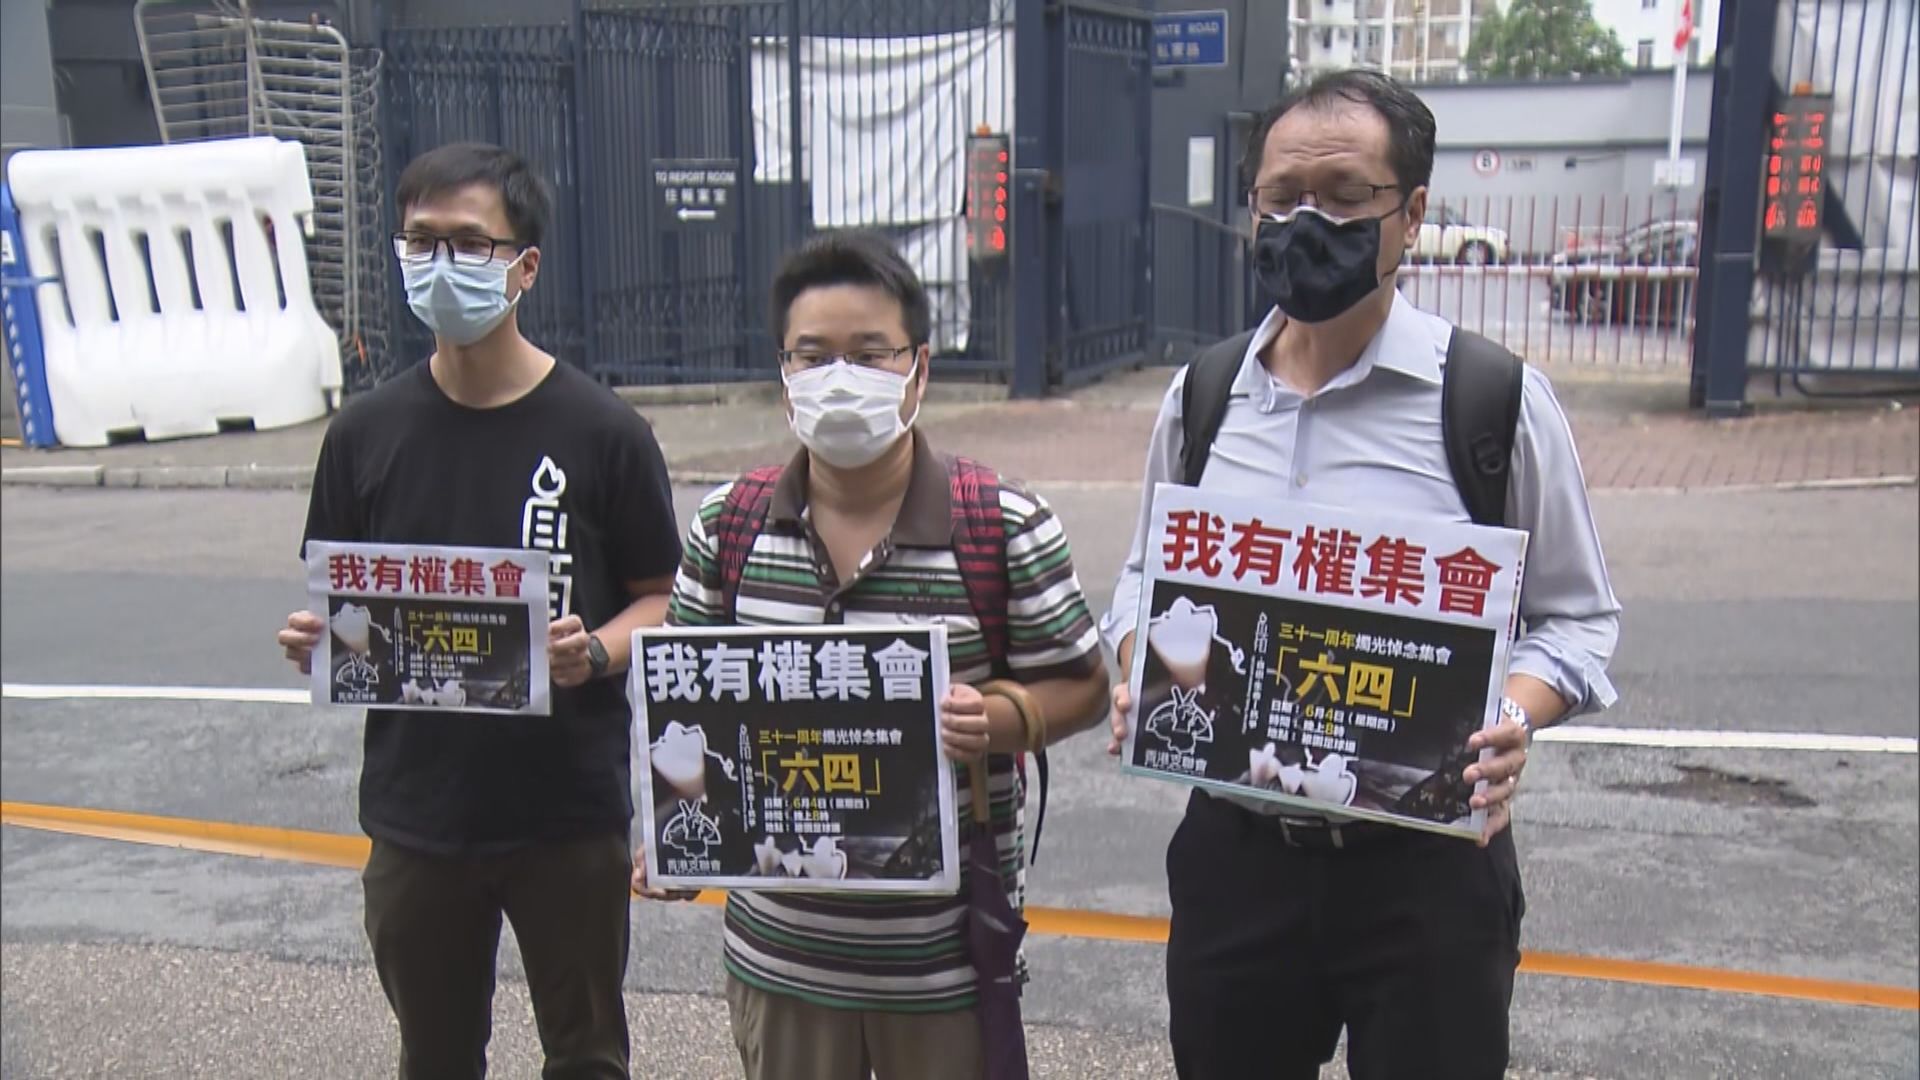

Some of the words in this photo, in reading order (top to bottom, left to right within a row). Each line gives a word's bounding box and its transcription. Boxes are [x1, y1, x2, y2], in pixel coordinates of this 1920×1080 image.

[1187, 21, 1219, 34] ROAD
[655, 171, 667, 185] TO
[668, 171, 705, 185] REPORT
[706, 171, 736, 185] ROOM
[329, 553, 526, 598] 我有權集會
[1162, 509, 1503, 617] 我有權集會
[408, 624, 492, 655] 「六四」
[1278, 621, 1452, 667] 三十一周年燭光悼念集會
[646, 638, 930, 703] 我有權集會
[1276, 645, 1417, 718] 「六四」
[758, 728, 903, 746] 三十一周年燭光悼念集會
[762, 749, 881, 796] 「六四」
